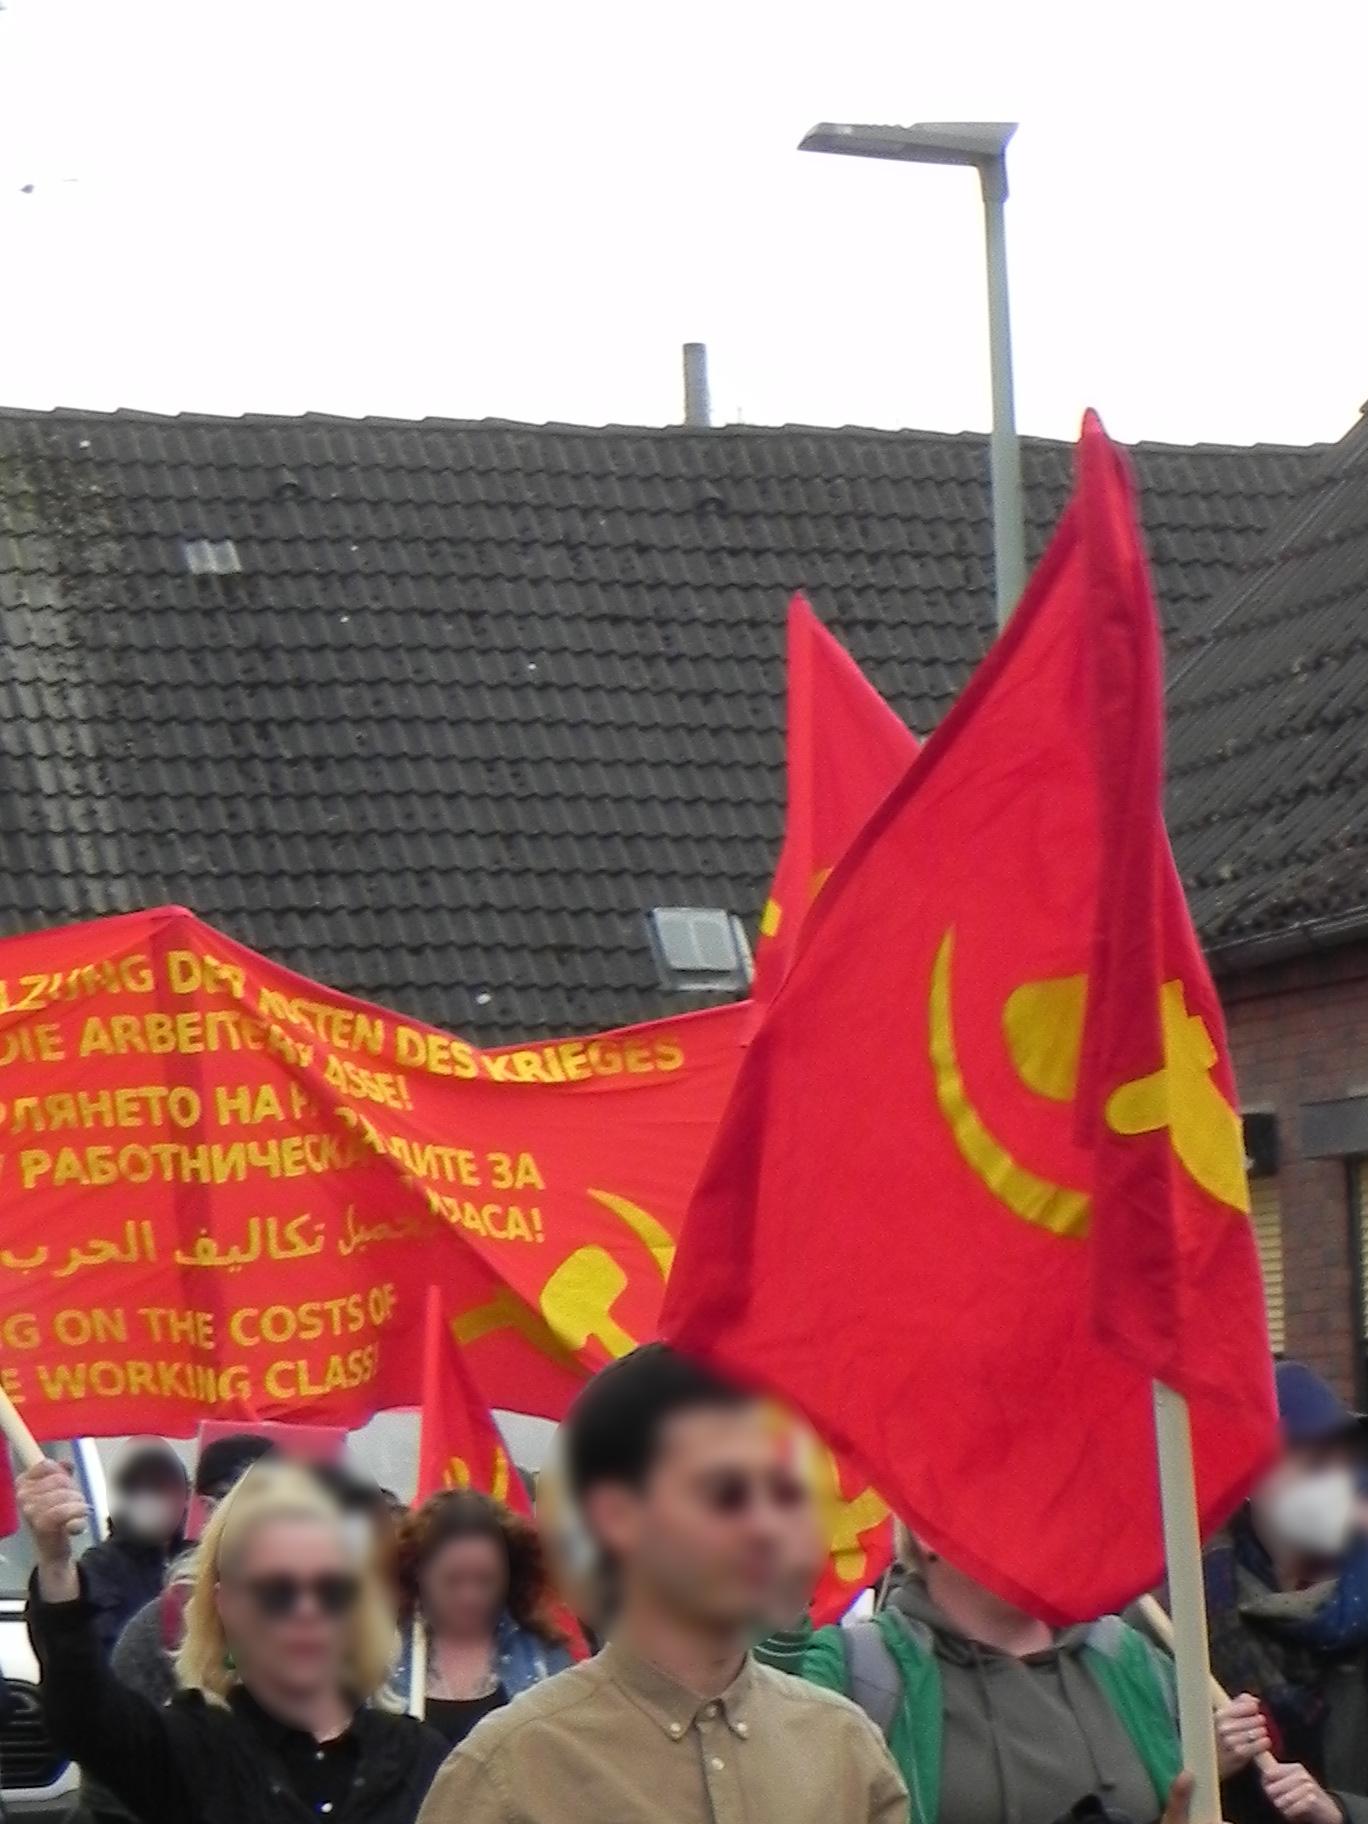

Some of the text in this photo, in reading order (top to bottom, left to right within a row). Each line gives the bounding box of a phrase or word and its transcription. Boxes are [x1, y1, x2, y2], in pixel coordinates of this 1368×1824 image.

[396, 1024, 480, 1080] DES
[481, 1035, 684, 1084] KRIEGES
[214, 1083, 285, 1127] НА
[487, 1151, 546, 1191] ЗА
[53, 1308, 128, 1347] ON
[136, 1307, 216, 1350] THE
[229, 1292, 366, 1347] COSTS
